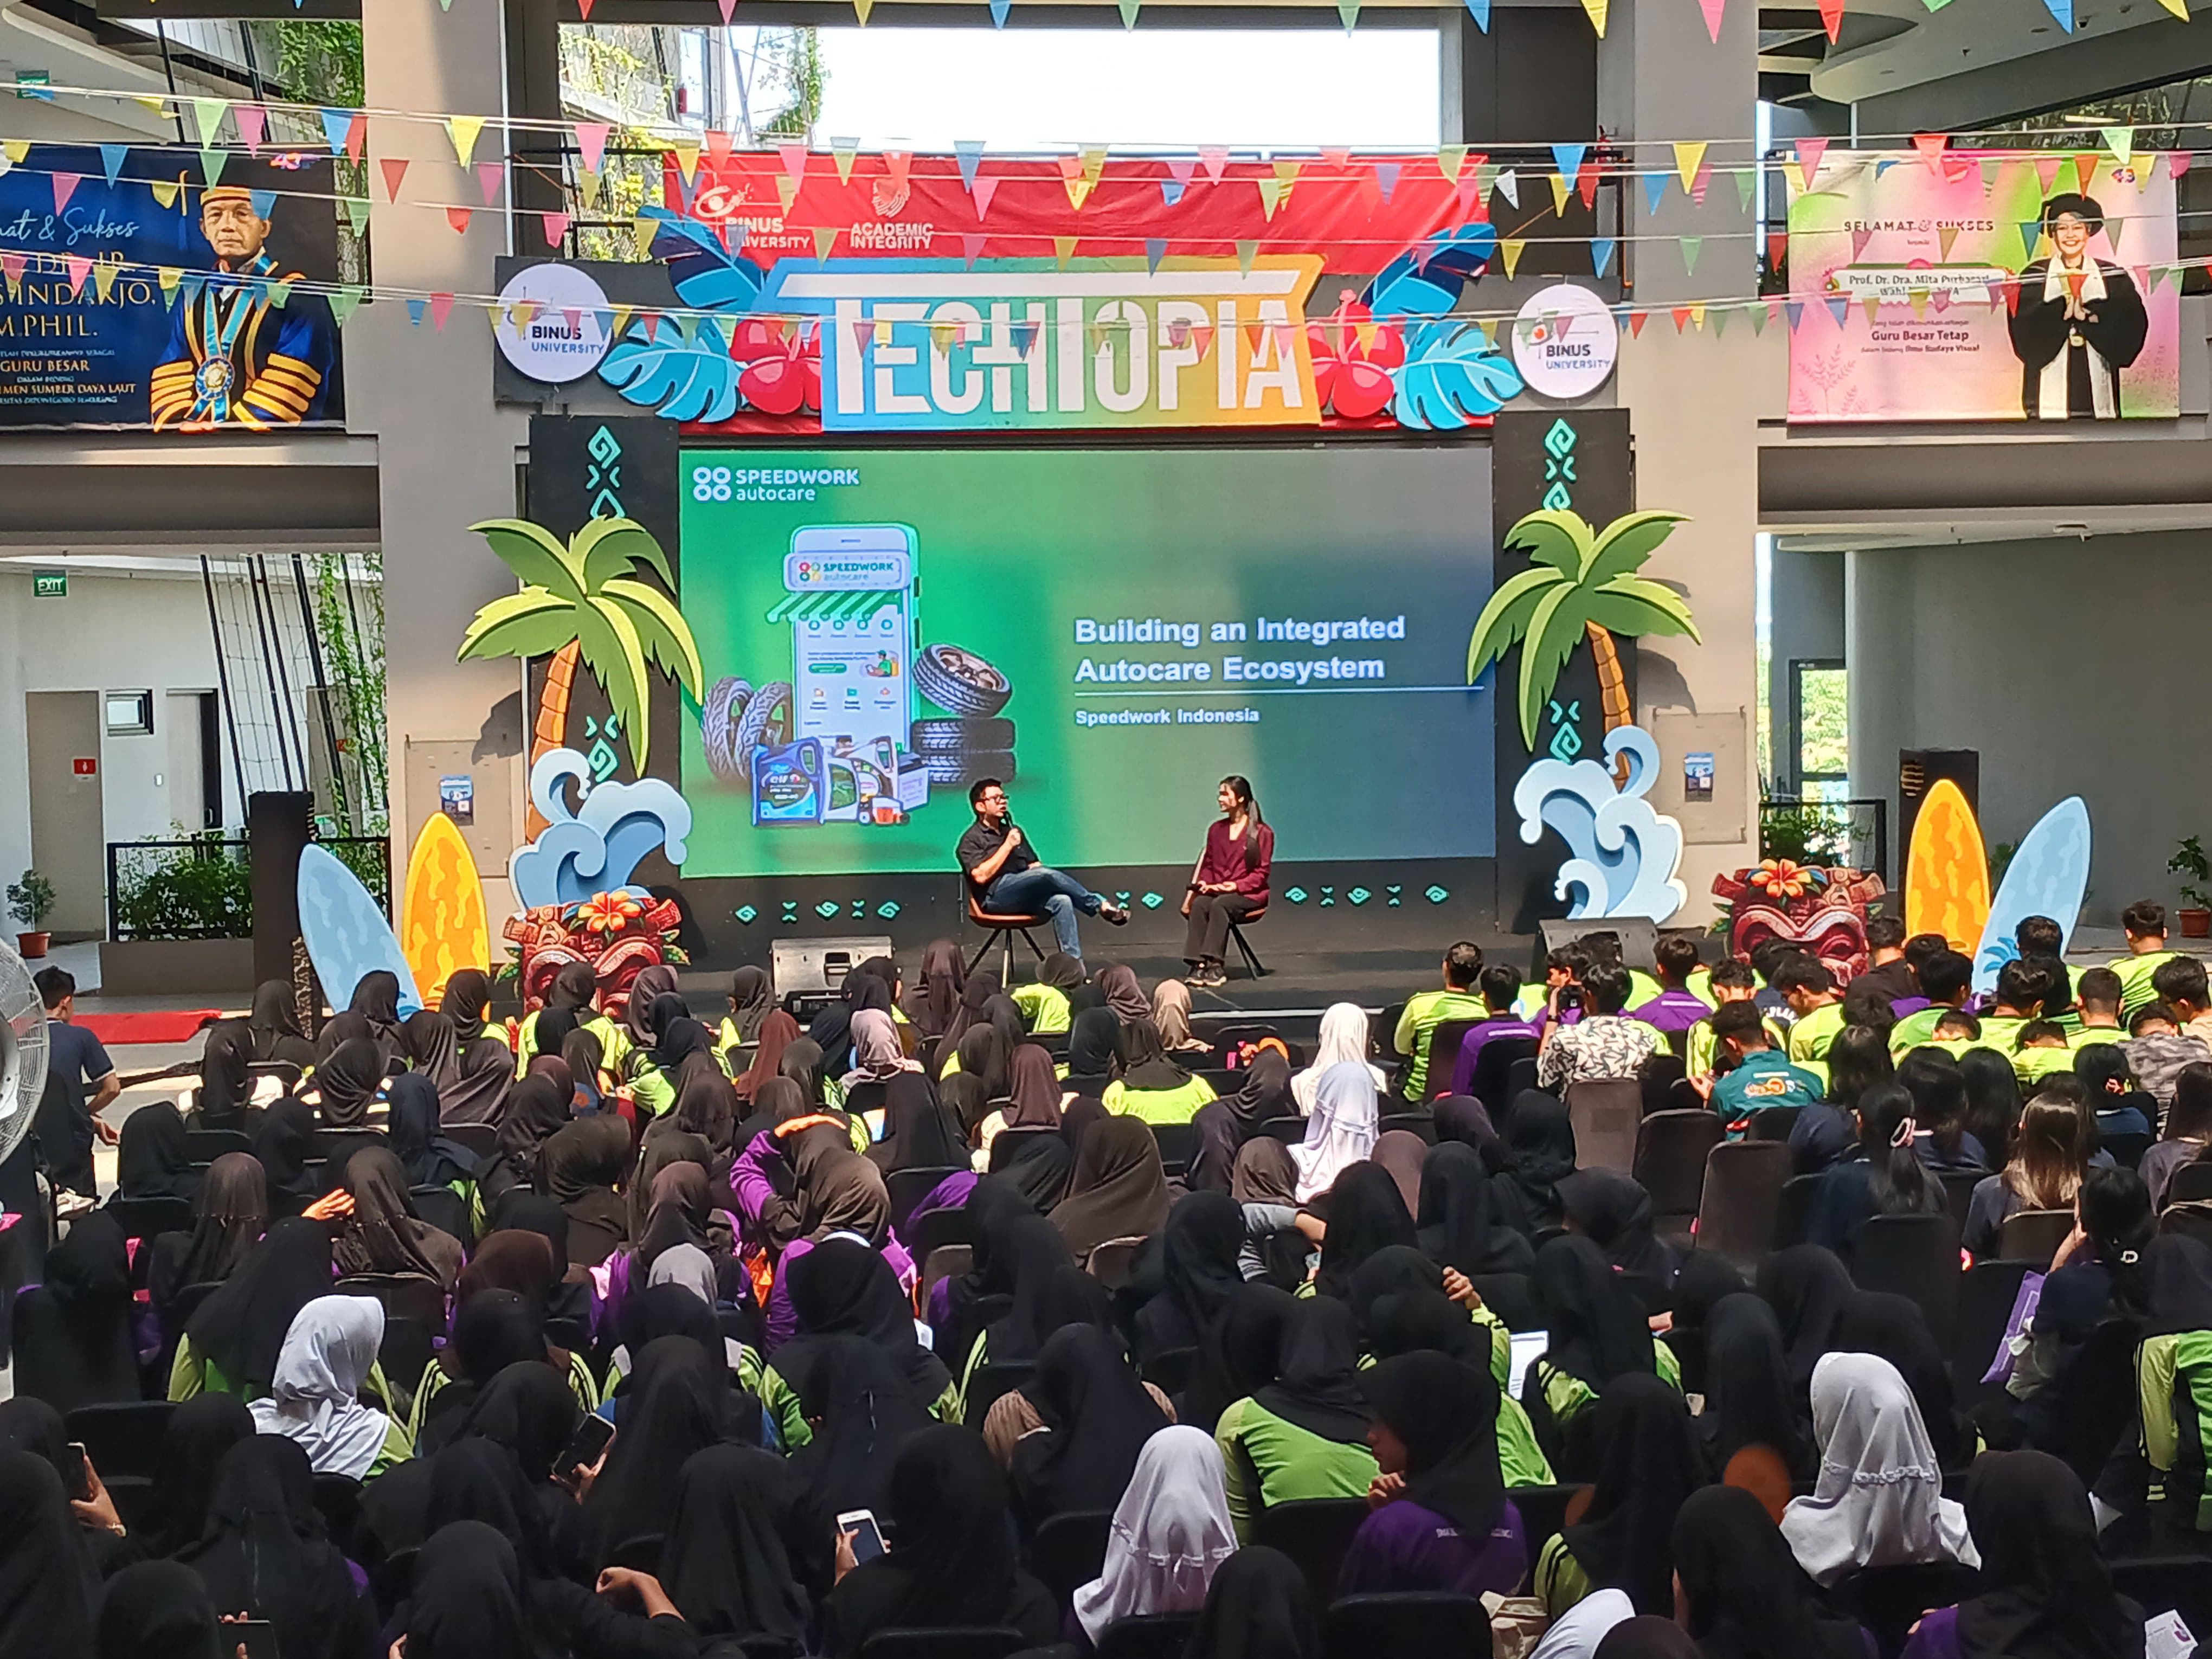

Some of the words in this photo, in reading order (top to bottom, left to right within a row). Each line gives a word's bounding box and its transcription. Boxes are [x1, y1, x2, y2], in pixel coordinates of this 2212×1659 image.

[38, 215, 55, 241] &
[63, 207, 140, 246] Sukses
[850, 222, 934, 236] ACADEMIC
[1844, 221, 1914, 232] SELAMAT
[850, 235, 933, 249] INTEGRITY
[1849, 275, 1873, 285] Prof.
[1875, 275, 1889, 285] Dr.
[531, 325, 582, 340] BINUS
[1872, 331, 1900, 340] Guru
[1903, 331, 1935, 340] Besar
[1937, 330, 1969, 342] Tetap
[531, 342, 605, 354] UNIVERSITY
[1546, 344, 1591, 357] BINUS
[0, 360, 42, 372] GURU
[48, 359, 90, 372] BESAR
[1546, 359, 1610, 369] UNIVERSITY
[108, 383, 137, 394] LAUT
[735, 468, 860, 485] SPEEDWORK
[736, 486, 816, 501] autocare
[823, 562, 894, 572] SPEEDWORK
[37, 578, 63, 591] EXIT
[1075, 619, 1200, 646] Building
[1210, 622, 1246, 642] an
[1257, 616, 1406, 645] Integrated
[1075, 658, 1211, 682] Autocare
[1223, 657, 1384, 685] Ecosystem
[1076, 709, 1171, 726] Speedwork
[1177, 708, 1259, 723] Indonesia
